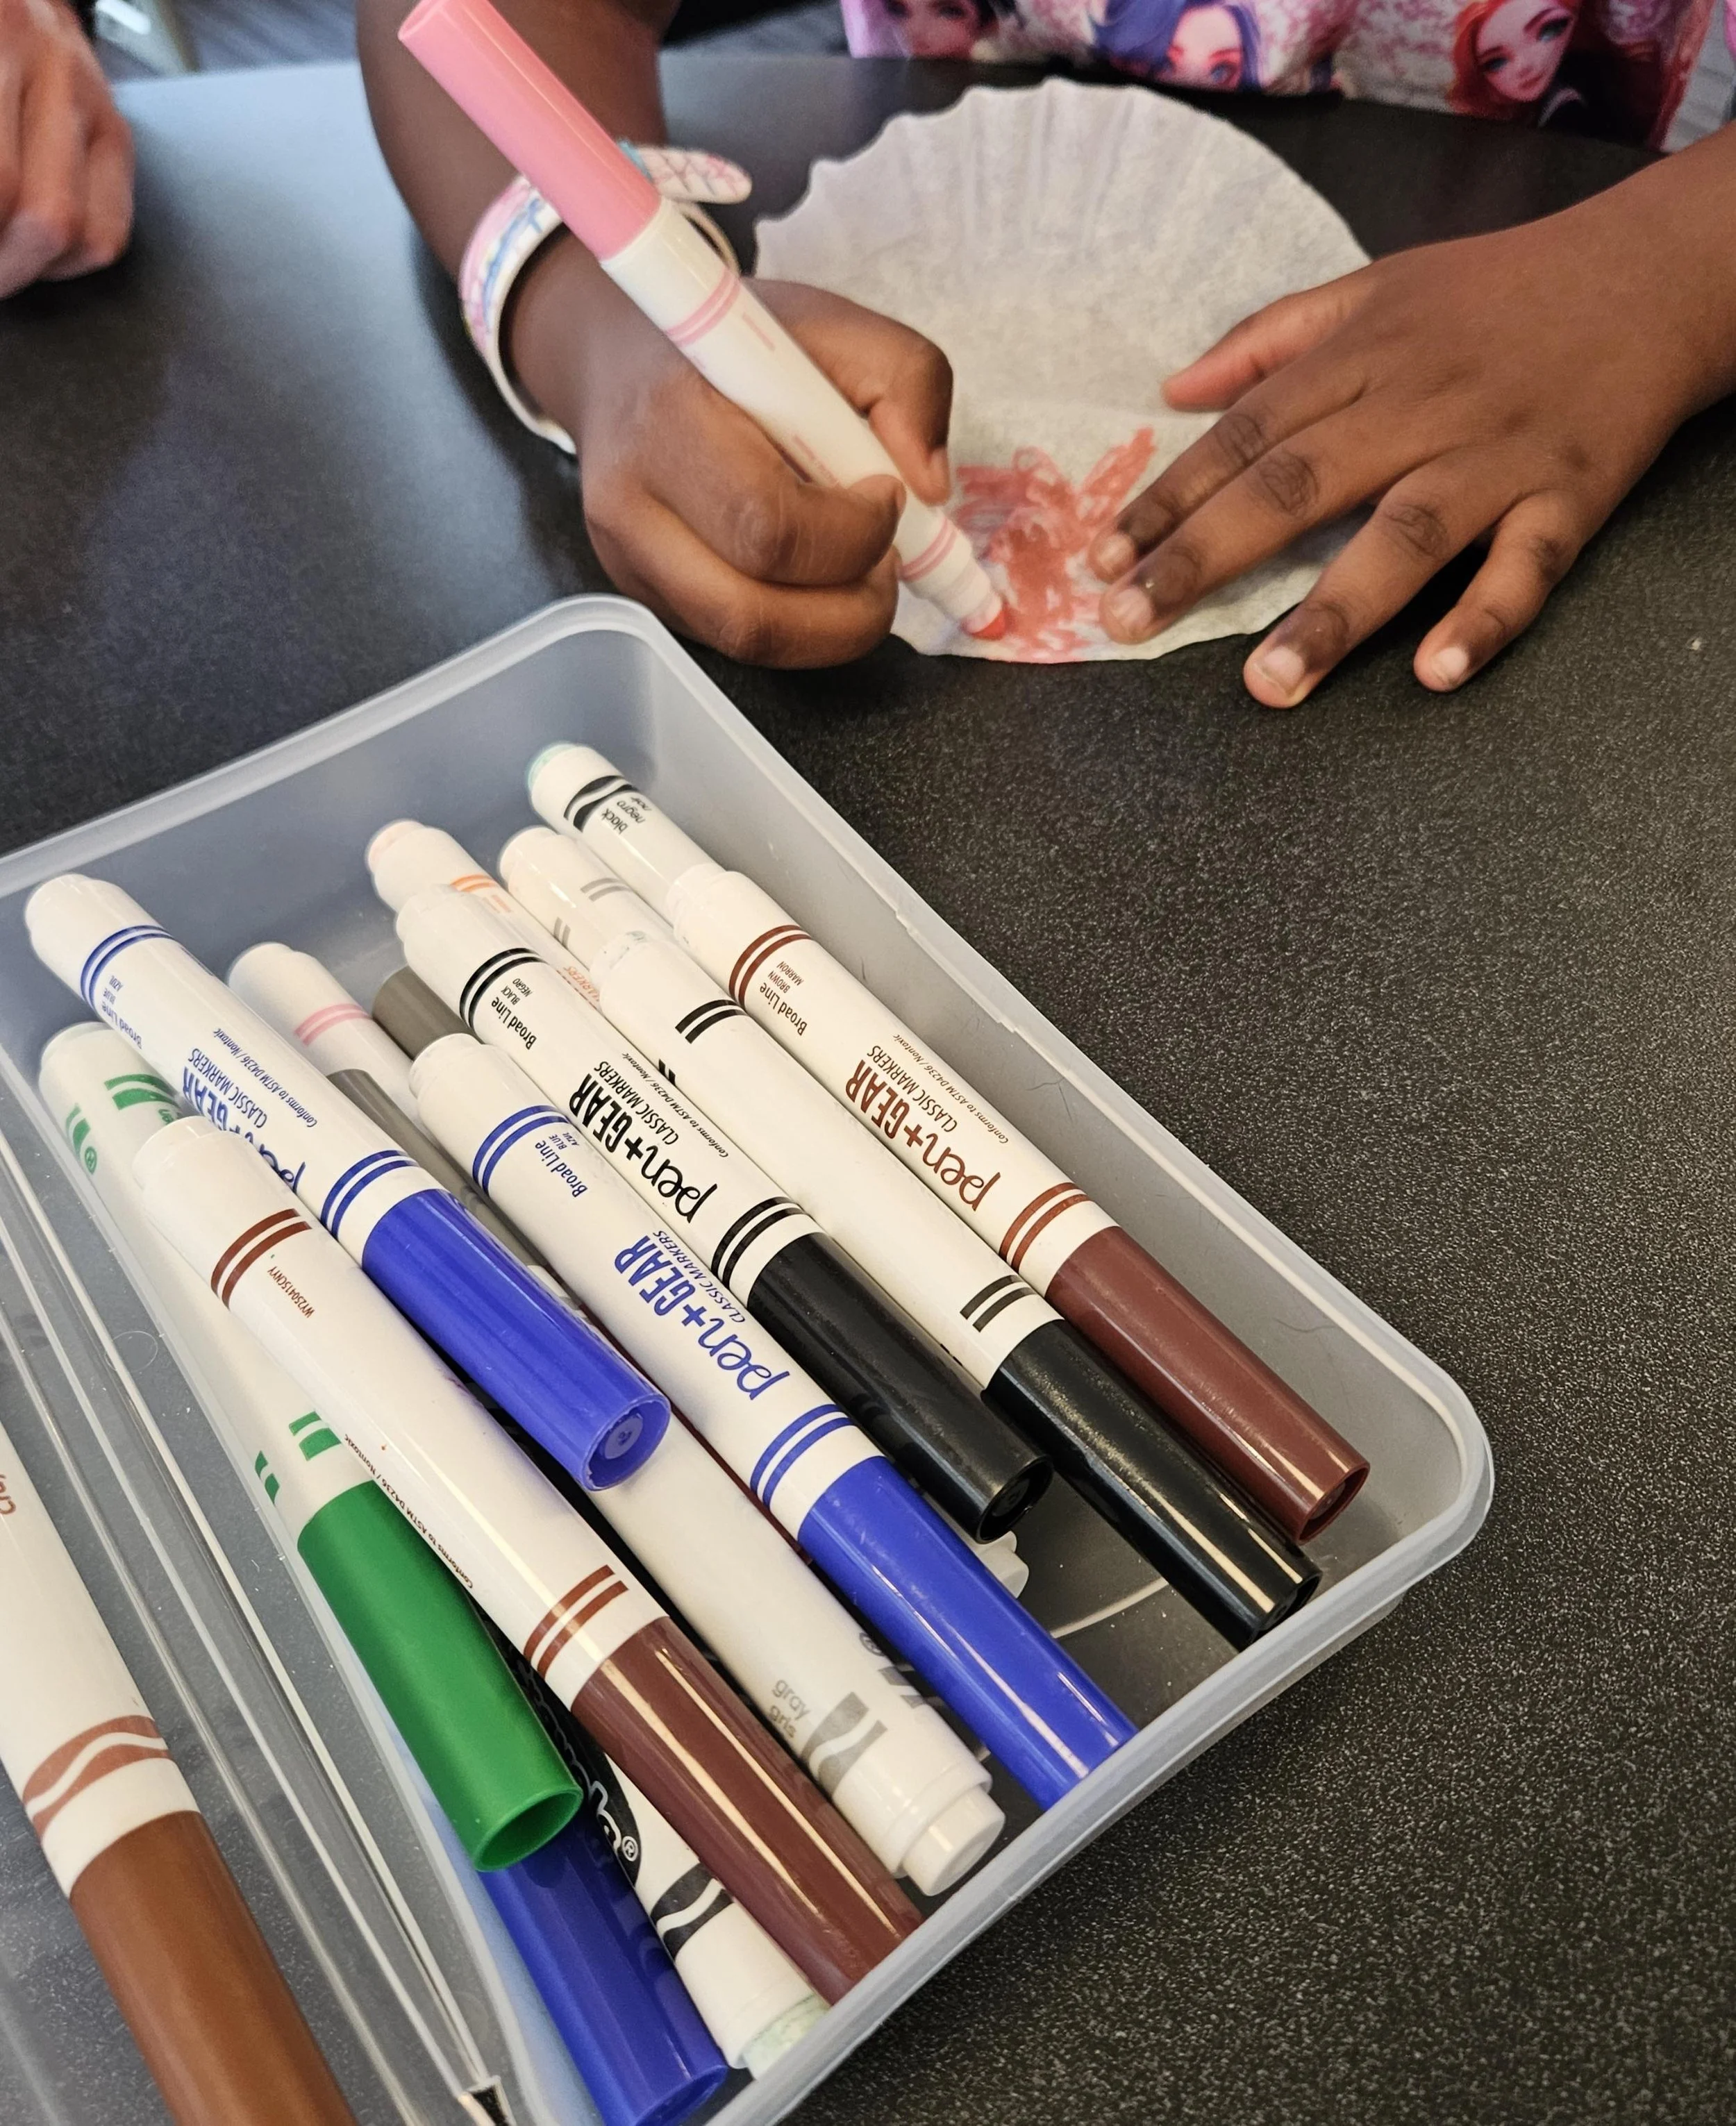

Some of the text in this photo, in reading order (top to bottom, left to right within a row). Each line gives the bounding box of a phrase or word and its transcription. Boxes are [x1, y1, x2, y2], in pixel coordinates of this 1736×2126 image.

[601, 807, 628, 835] black
[616, 800, 646, 824] negro
[501, 985, 521, 1005] BLACK
[512, 978, 533, 997] NEGRO
[767, 970, 791, 994] BROWN
[491, 996, 537, 1050] Broad Line
[760, 982, 808, 1036] Broad Line
[119, 1018, 143, 1050] Broad
[213, 1028, 243, 1056] Nontoxic
[892, 1034, 924, 1063] Nontoxic
[240, 1055, 265, 1078] D4236
[621, 1052, 651, 1079] Nontoxic
[924, 1064, 950, 1087] D4236
[188, 1048, 267, 1129] CLASSIC MARKERS
[259, 1073, 283, 1093] ASTM
[278, 1090, 289, 1100] to
[650, 1082, 675, 1103] D4236
[867, 1045, 958, 1133] CLASSIC MARKERS
[945, 1085, 969, 1105] ASTM
[285, 1097, 317, 1128] Conforms
[594, 1061, 679, 1145] CLASSIC MARKERS
[669, 1102, 692, 1120] ASTM
[967, 1104, 976, 1113] to
[689, 1119, 699, 1128] to
[845, 1059, 1001, 1212] pen+GEAR
[974, 1112, 1009, 1144] Conforms
[549, 1134, 568, 1150] BLUE
[562, 1132, 580, 1147] AZUL
[569, 1073, 718, 1223] pen+GEAR
[696, 1127, 728, 1157] Conforms
[535, 1140, 588, 1198] Broad Line
[653, 1230, 746, 1323] CLASSIC MARKERS
[615, 1235, 790, 1401] pen+GEAR
[344, 1433, 376, 1476] Nontoxic
[381, 1478, 406, 1509] D4236
[406, 1507, 428, 1534] ASTM
[428, 1533, 436, 1546] to
[437, 1543, 473, 1589] Conforms
[771, 1679, 812, 1721] gray
